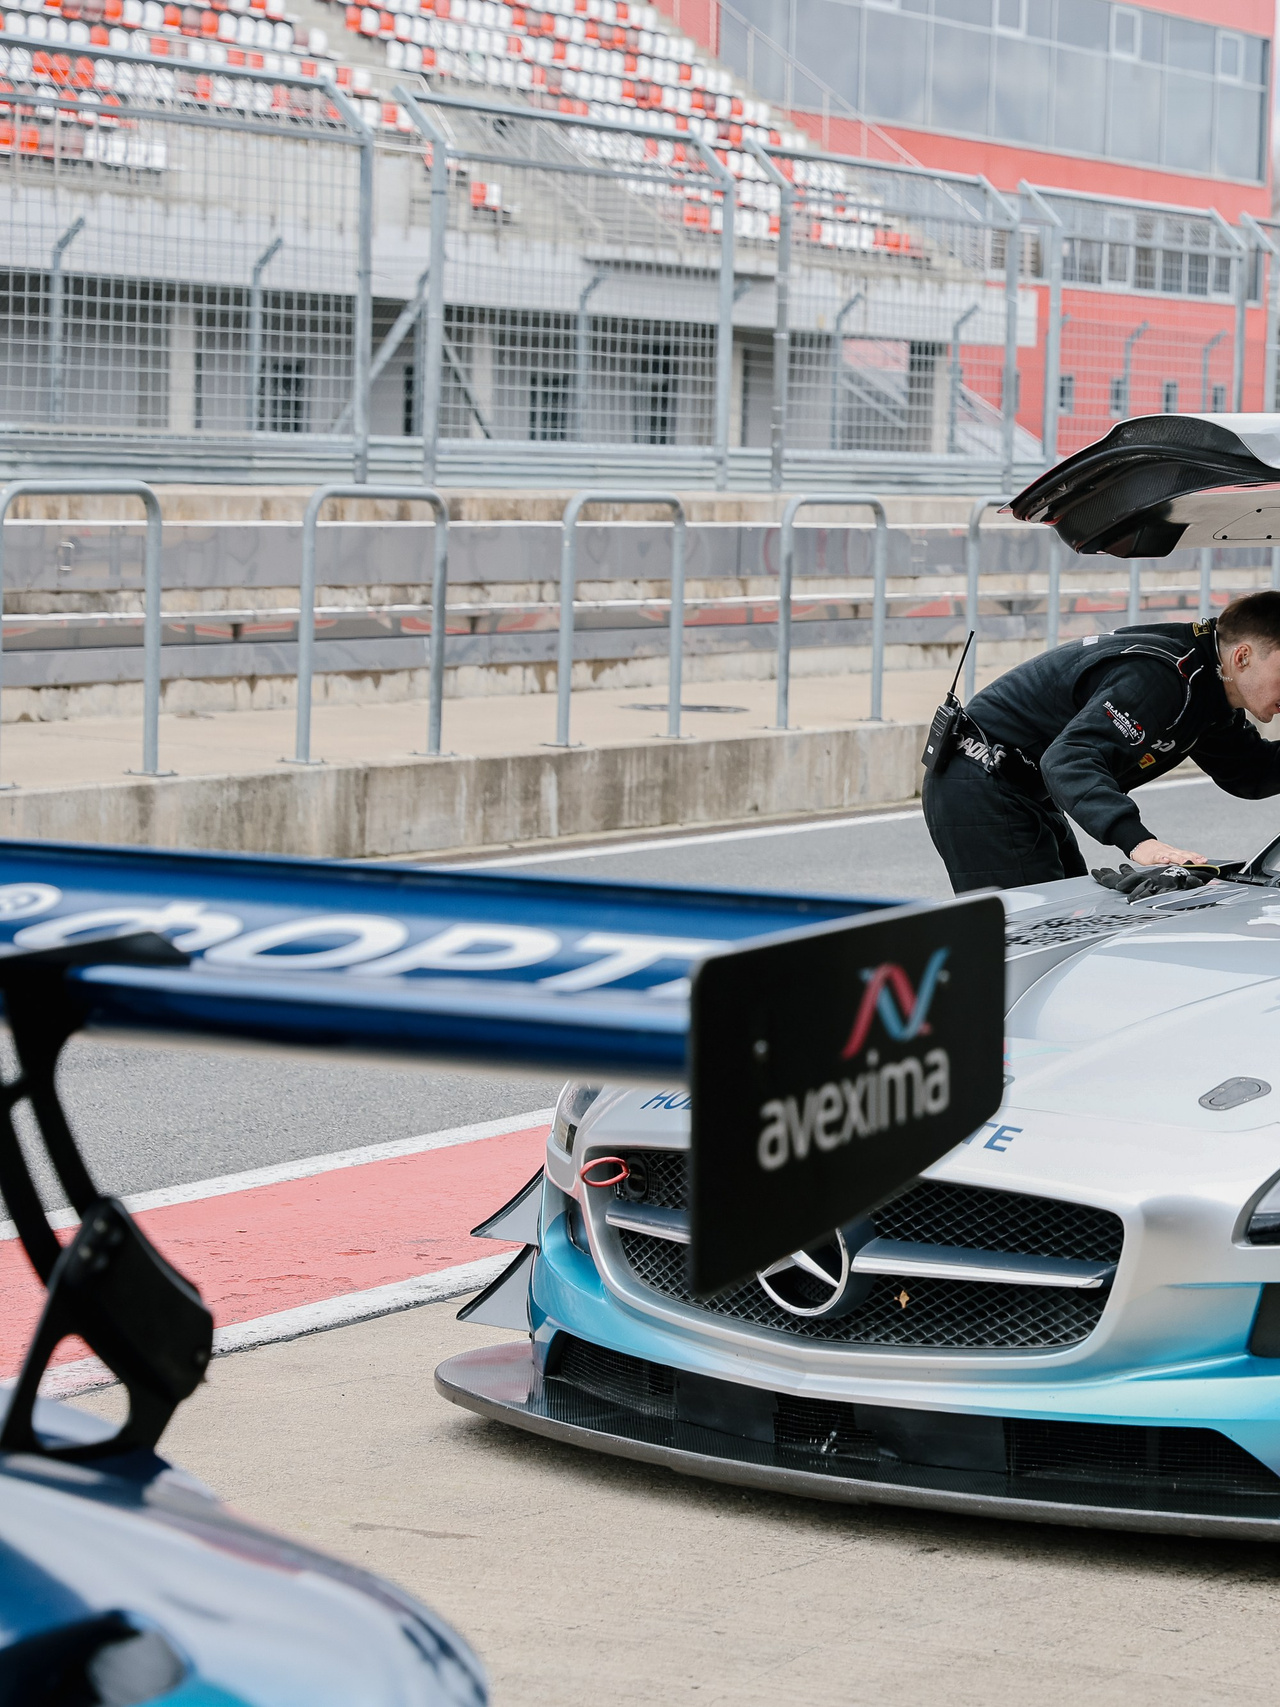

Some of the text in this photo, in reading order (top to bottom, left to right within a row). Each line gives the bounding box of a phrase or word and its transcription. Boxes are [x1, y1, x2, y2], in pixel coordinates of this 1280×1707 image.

[1103, 701, 1140, 738] BLANCPAIN
[13, 902, 735, 998] ФОРТ
[757, 1048, 950, 1171] avexima
